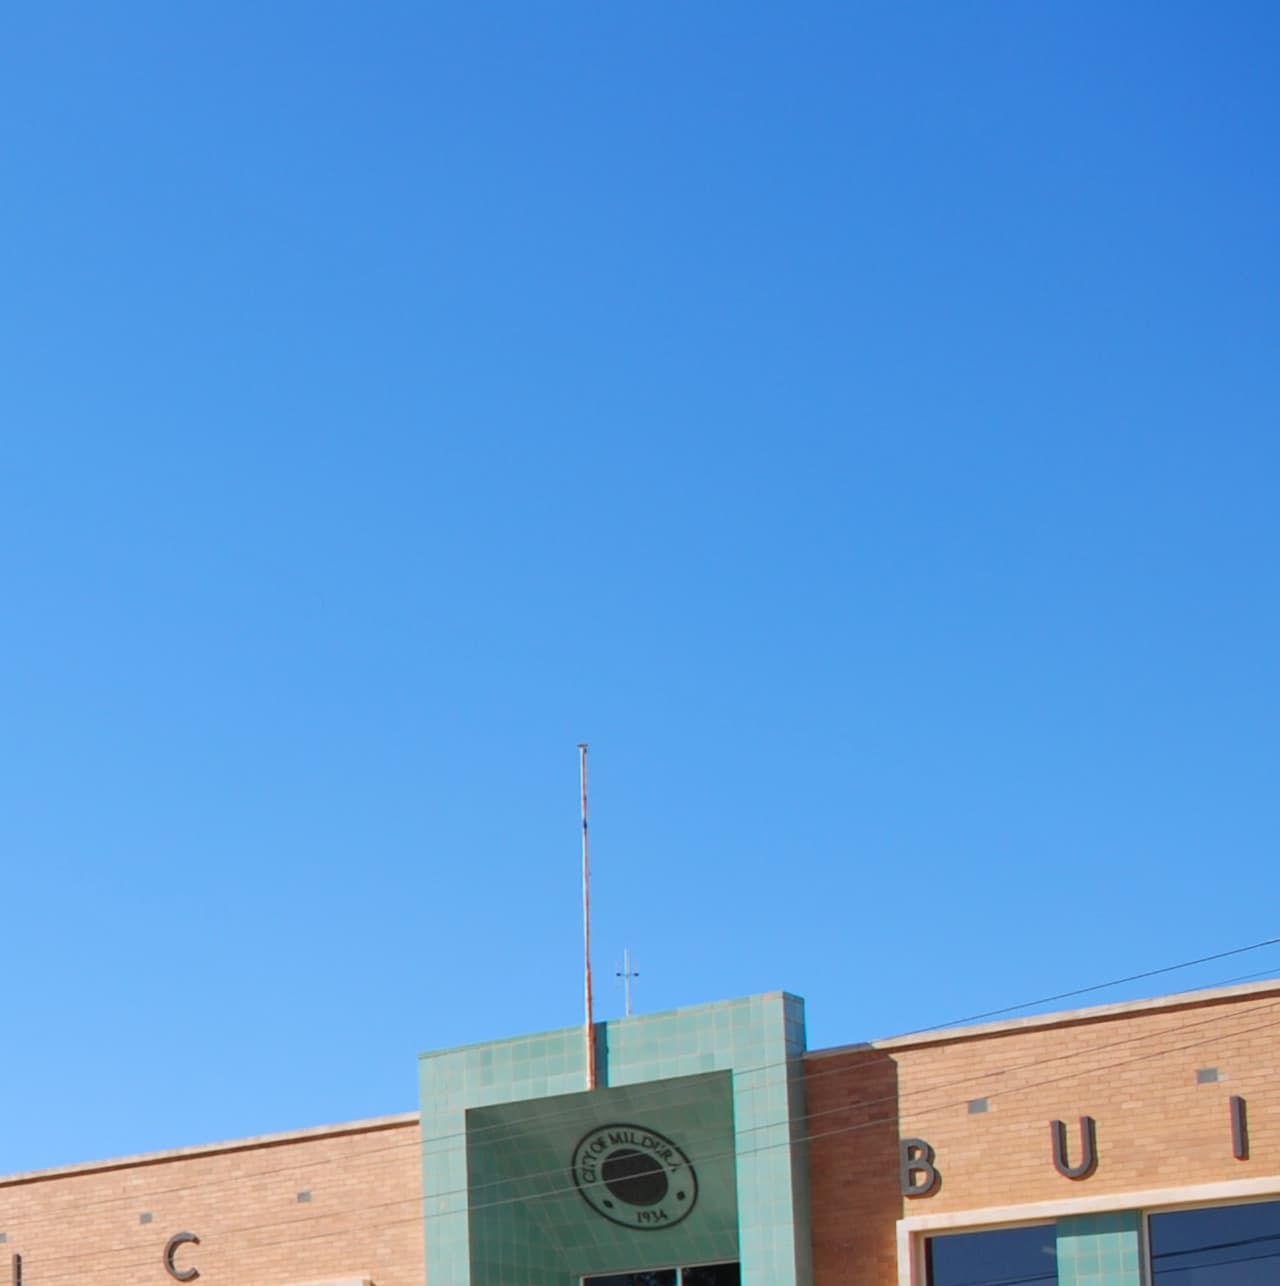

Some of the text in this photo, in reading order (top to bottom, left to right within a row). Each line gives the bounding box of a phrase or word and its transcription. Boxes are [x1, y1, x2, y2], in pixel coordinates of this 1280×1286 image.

[583, 1131, 681, 1183] CITY OF MILDURA
[637, 1208, 668, 1223] 1934
